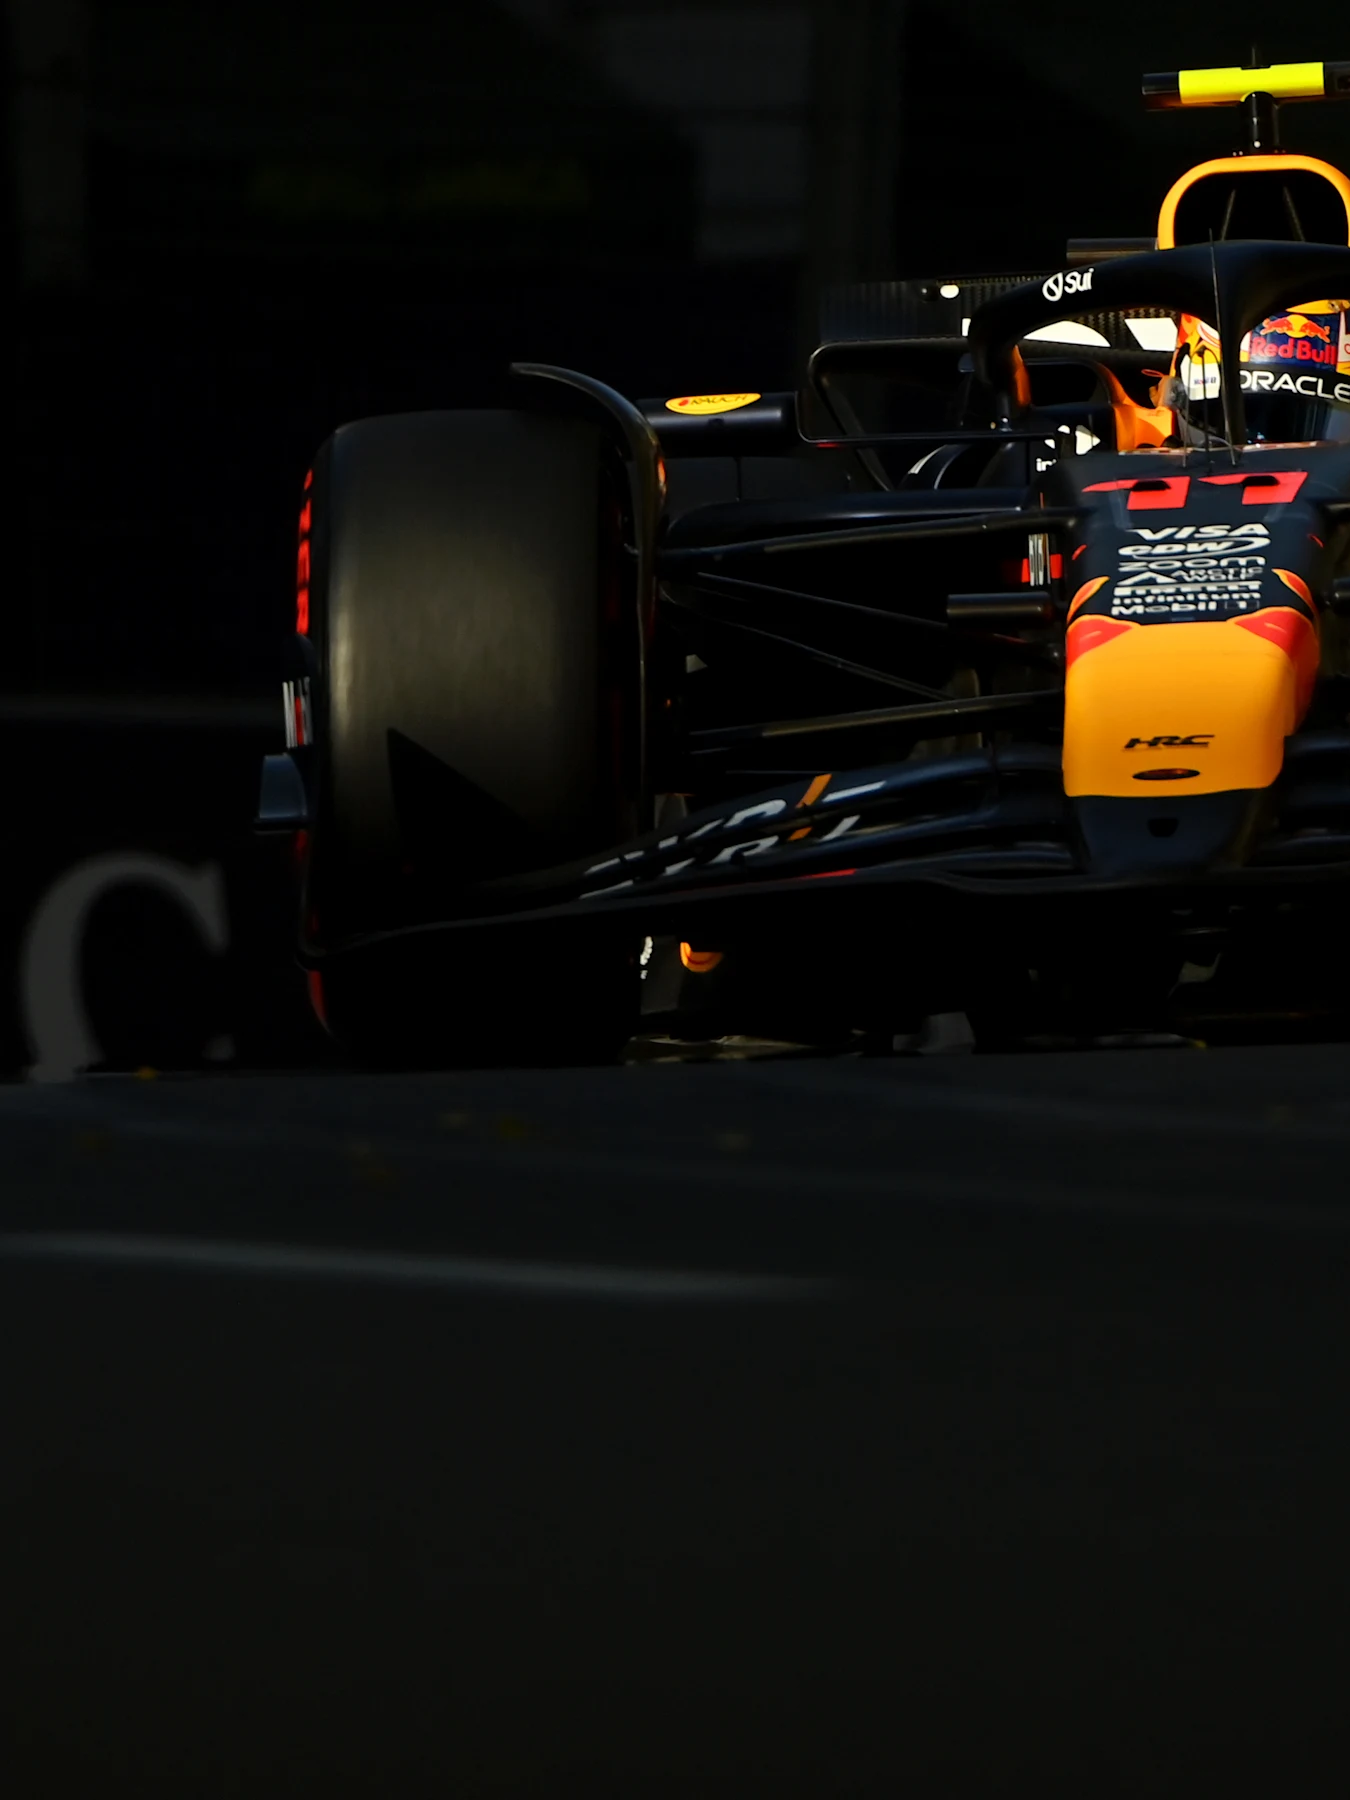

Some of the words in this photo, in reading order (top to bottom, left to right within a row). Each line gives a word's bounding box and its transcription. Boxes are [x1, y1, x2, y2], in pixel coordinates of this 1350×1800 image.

[1251, 336, 1294, 359] Red
[1296, 340, 1336, 365] Bull
[1126, 523, 1270, 540] VISA
[1111, 601, 1217, 615] Mobil
[1124, 735, 1215, 749] HRC
